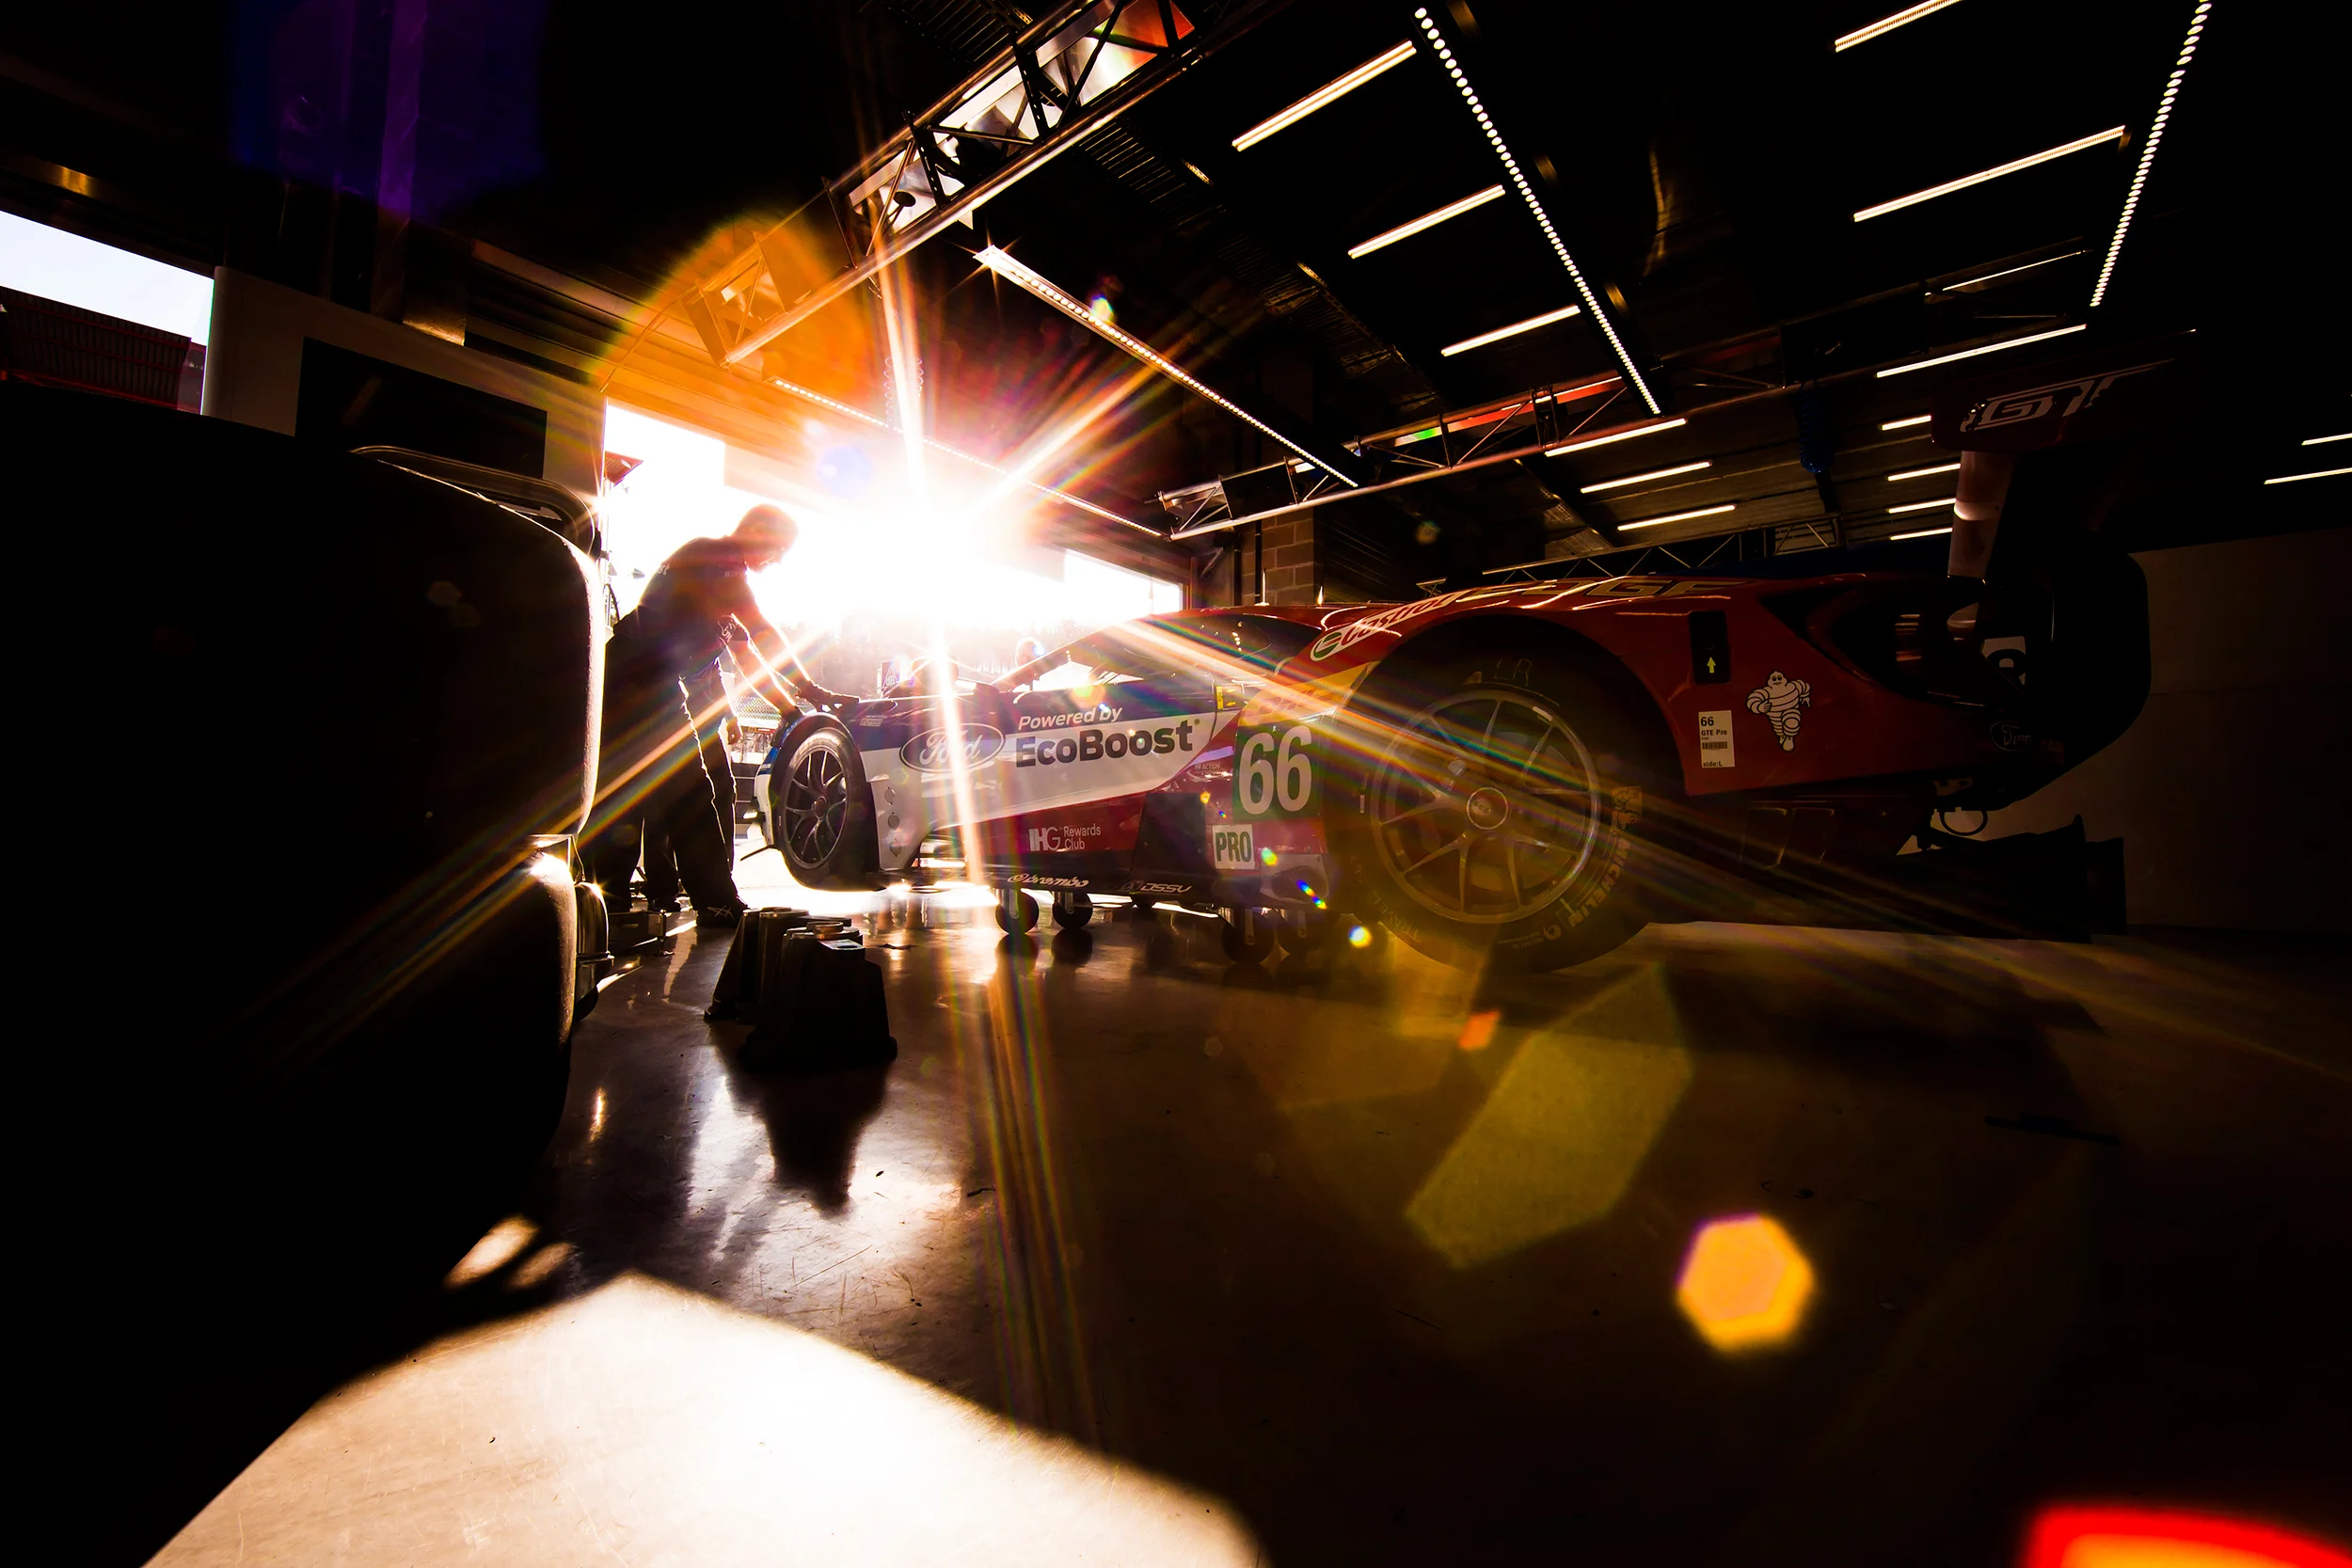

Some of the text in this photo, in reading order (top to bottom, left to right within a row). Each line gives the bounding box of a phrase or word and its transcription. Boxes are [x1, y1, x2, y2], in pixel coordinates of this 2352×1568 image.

[1960, 357, 2176, 433] GT
[1018, 706, 1122, 731] Powered by
[1700, 716, 1714, 727] 66
[1239, 725, 1312, 816] 66
[1028, 823, 1102, 852] IHG Rewards
[1064, 837, 1086, 850] Club
[1215, 831, 1252, 863] PRO
[1141, 881, 1193, 894] DSSV
